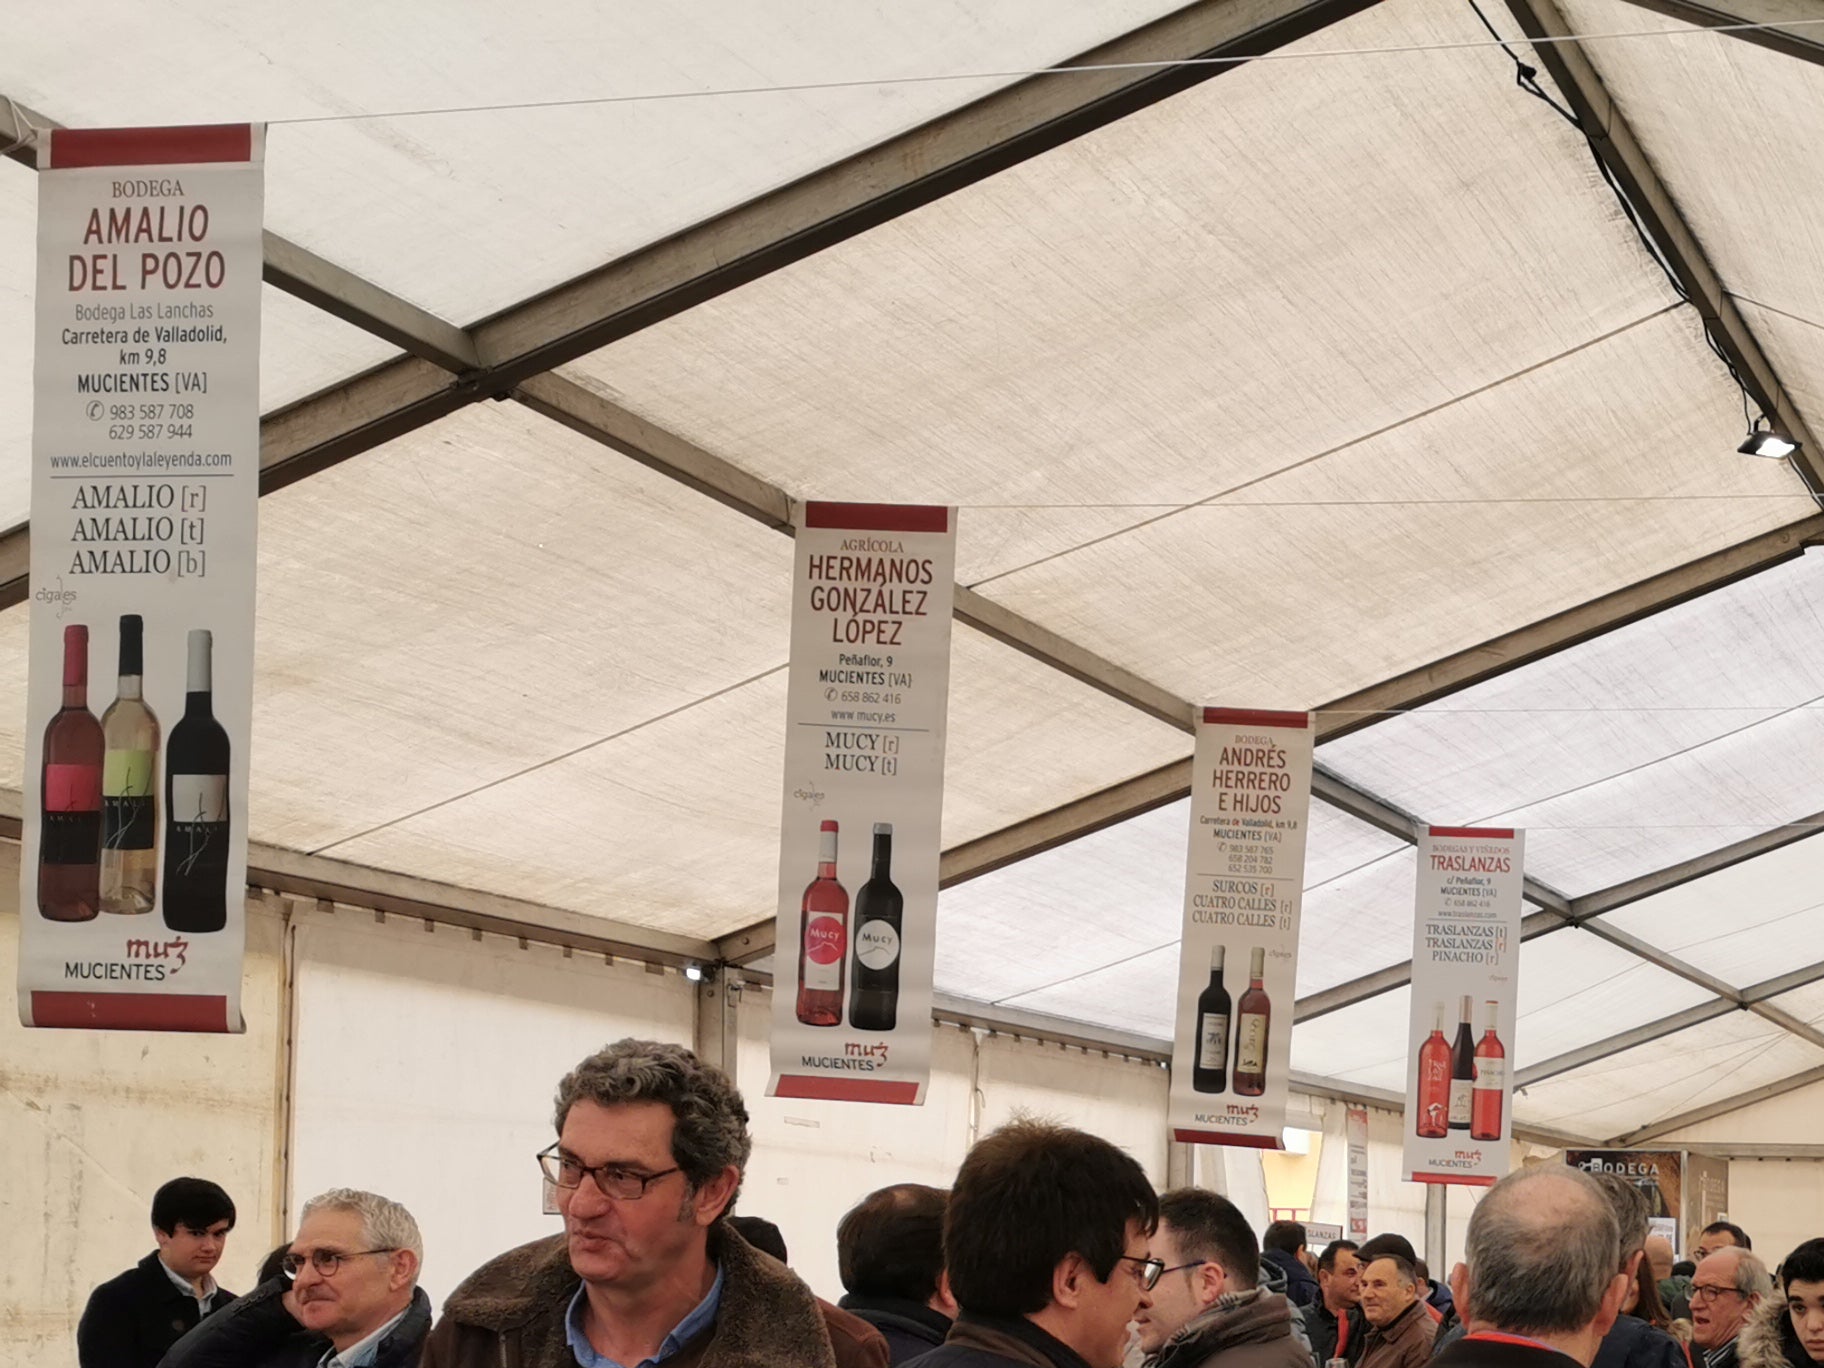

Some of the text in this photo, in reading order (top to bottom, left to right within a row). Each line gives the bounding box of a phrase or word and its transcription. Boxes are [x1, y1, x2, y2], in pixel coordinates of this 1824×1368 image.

[112, 179, 184, 198] BODEGA
[84, 204, 209, 244] AMALIO
[69, 251, 225, 291] DEL POZO
[75, 302, 213, 325] Bodega Las Lanchas
[62, 325, 227, 345] Carretera de Valladolid,
[120, 349, 166, 367] km 9,8
[78, 372, 207, 393] MUCIENTES [VA]
[110, 404, 194, 420] 983 587 708
[109, 424, 193, 440] 629 587 944
[72, 484, 206, 512] AMALIO [r]
[71, 516, 204, 544] AMALIO [t]
[840, 537, 904, 553] AGRÍCOLA
[69, 549, 205, 577] AMALIO [b]
[809, 554, 933, 585] HERMANOS
[810, 580, 928, 616] GONZÁLEZ
[833, 612, 903, 645] LÓPEZ
[887, 655, 893, 666] 9
[819, 671, 885, 685] MUCIENTES
[826, 732, 880, 751] MUCY
[825, 754, 878, 773] MUCY
[1219, 745, 1286, 768] ANDRÉS
[1212, 769, 1290, 792] HERRERO
[1218, 793, 1281, 814] E HIJOS
[1213, 828, 1262, 841] MUCIENTES
[1430, 855, 1511, 873] TRASLANZAS
[1212, 879, 1257, 894] SURCOS
[1441, 887, 1481, 896] MUCIENTES
[1193, 894, 1236, 910] CUATRO
[1238, 897, 1276, 912] CALLES
[1192, 910, 1235, 926] CUATRO
[1236, 913, 1275, 927] CALLES
[1426, 924, 1494, 937] TRASLANZAS
[1426, 937, 1493, 950] TRASLANZAS
[1432, 951, 1483, 963] PINACHO
[65, 963, 166, 981] MUCIENTES
[802, 1056, 875, 1072] MUCIENTES
[1195, 1114, 1247, 1126] MUCIENTES
[1429, 1159, 1472, 1168] MUCIENTES
